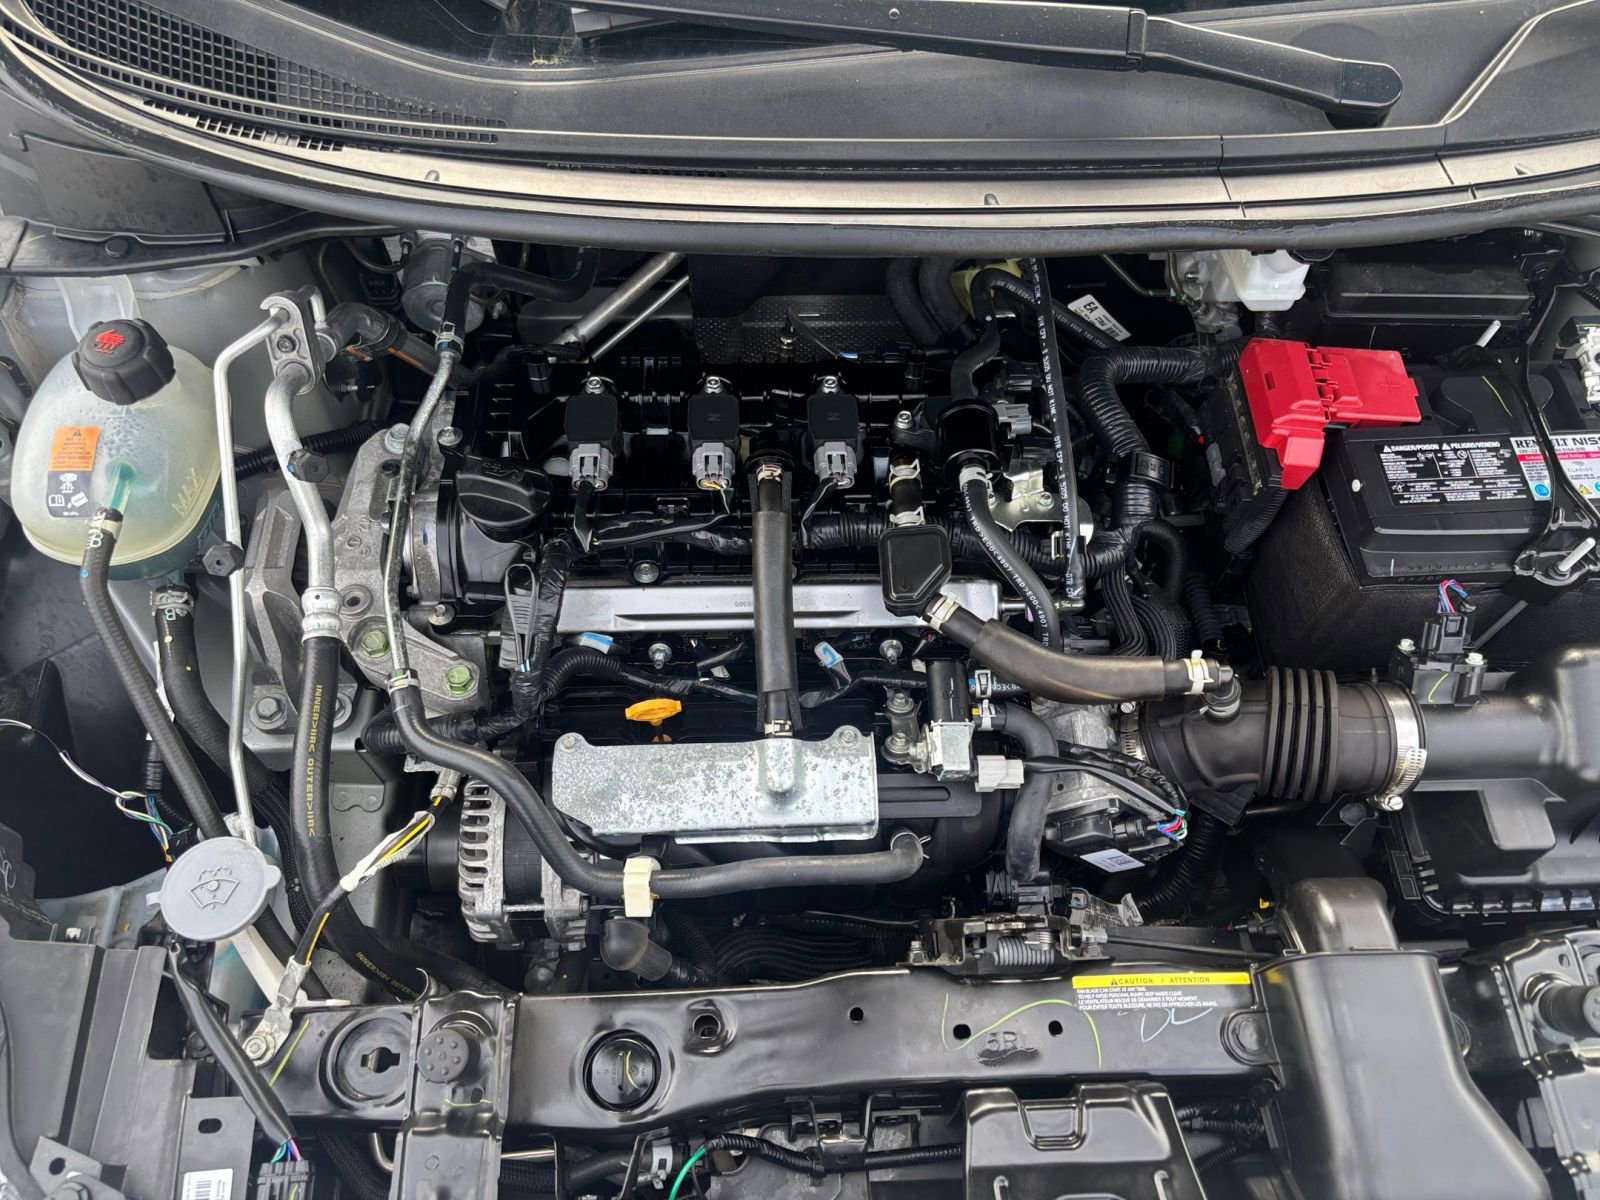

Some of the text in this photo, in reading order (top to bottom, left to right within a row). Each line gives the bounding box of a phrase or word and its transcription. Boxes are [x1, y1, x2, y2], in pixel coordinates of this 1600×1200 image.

[1083, 301, 1098, 314] EA
[1391, 444, 1440, 452] DANGER/POISON
[1450, 441, 1501, 449] PELIGRO/VENENO
[1118, 977, 1154, 985] CAUTION
[1169, 976, 1210, 984] ATTENTION
